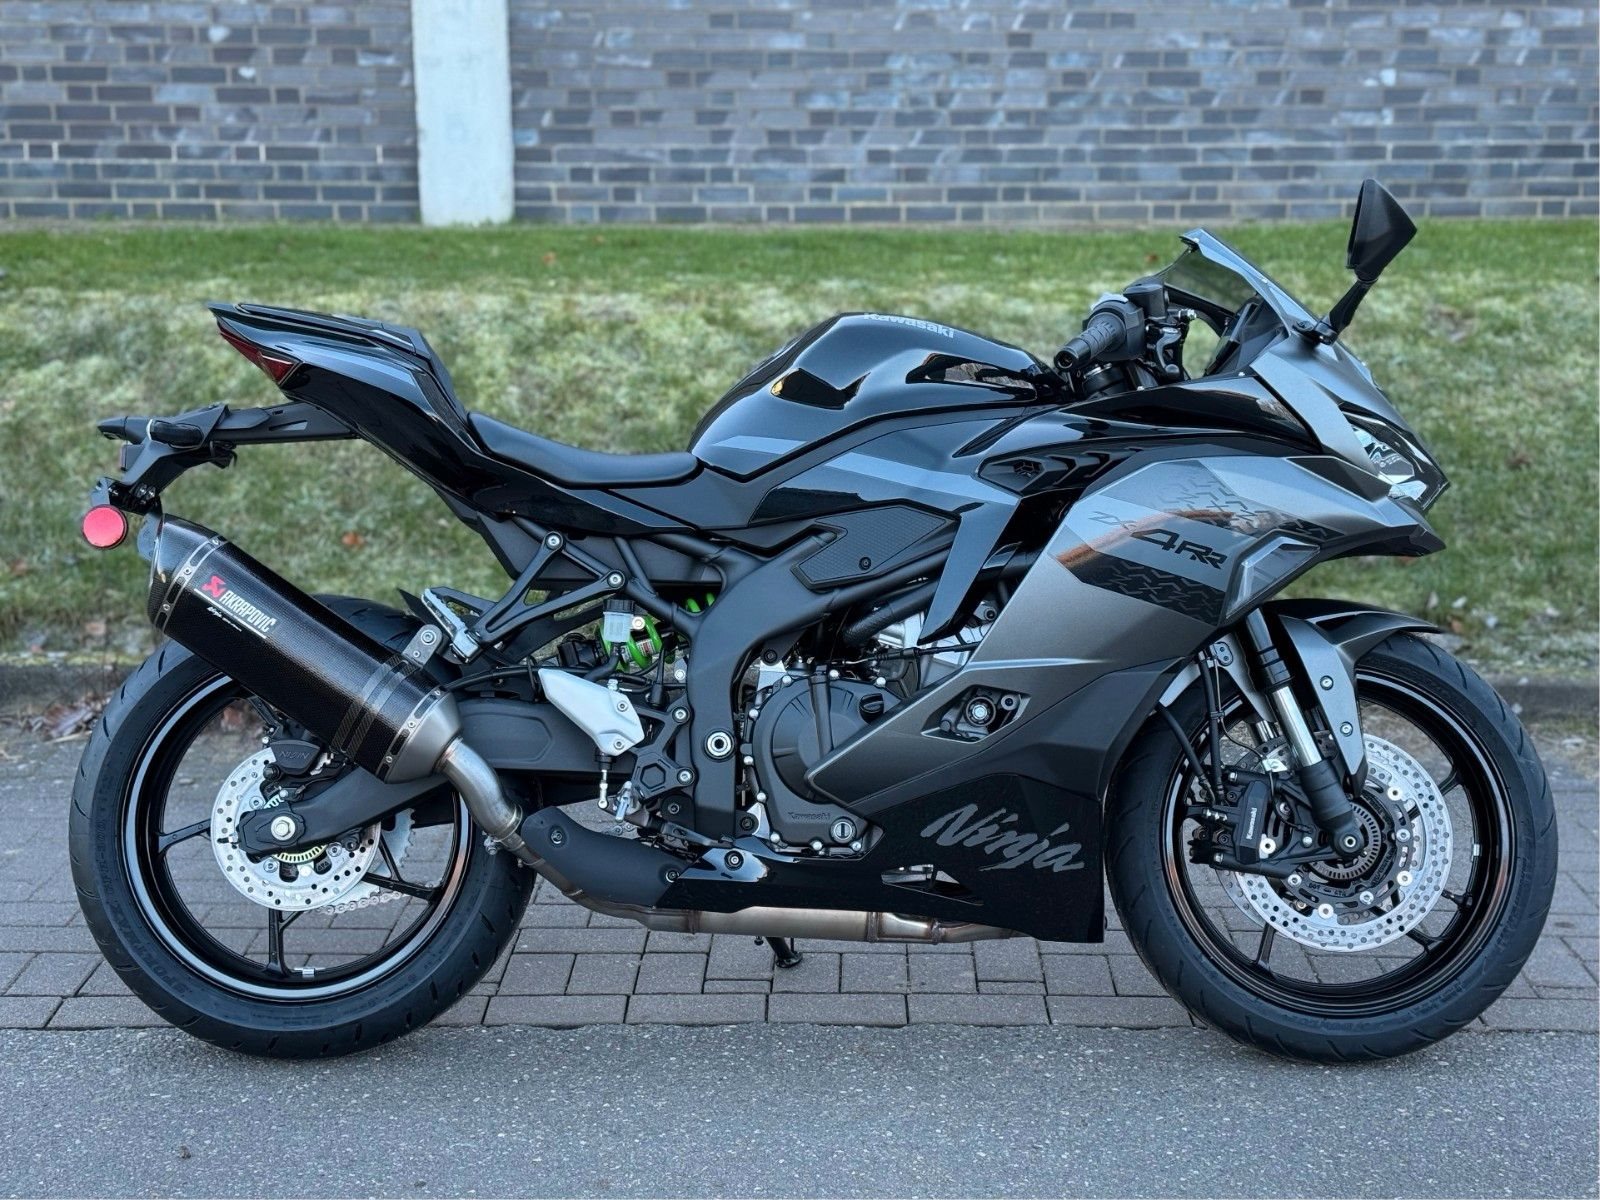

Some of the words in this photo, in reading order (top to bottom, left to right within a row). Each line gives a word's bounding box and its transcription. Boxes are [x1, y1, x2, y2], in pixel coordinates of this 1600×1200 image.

[864, 313, 954, 338] Kawasaki
[920, 803, 1085, 872] Ninja
[1246, 807, 1257, 840] Kawasaki
